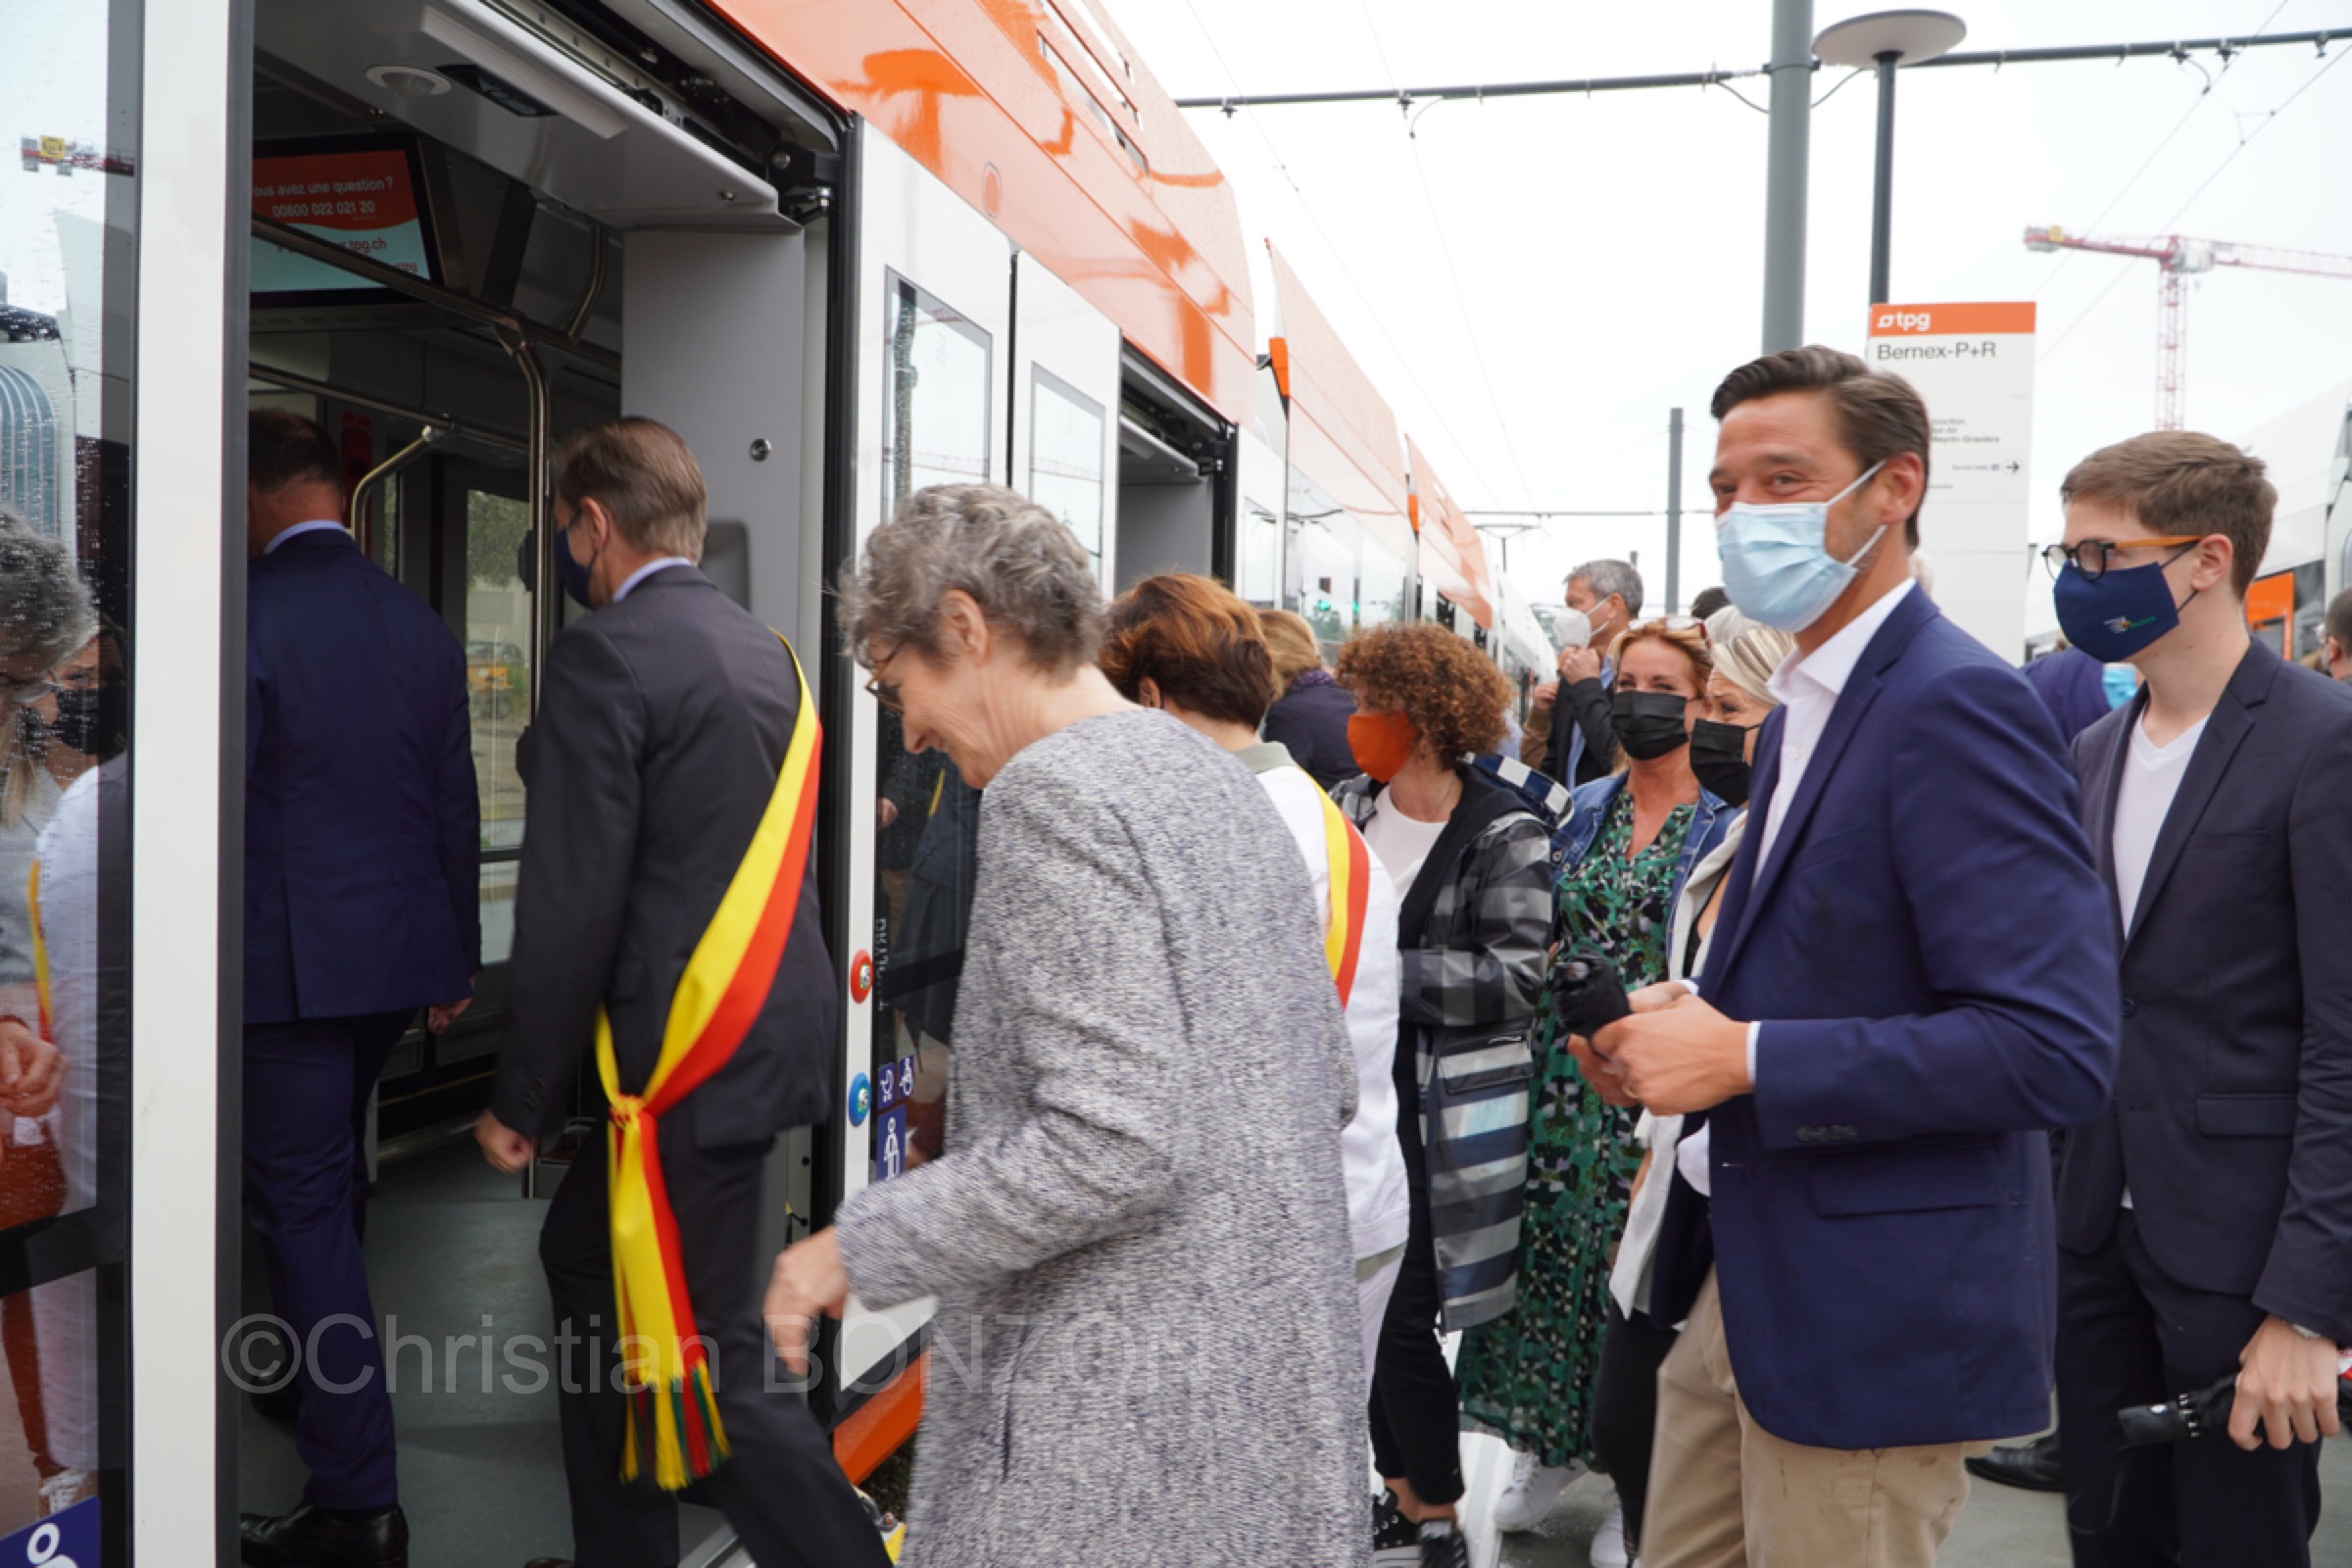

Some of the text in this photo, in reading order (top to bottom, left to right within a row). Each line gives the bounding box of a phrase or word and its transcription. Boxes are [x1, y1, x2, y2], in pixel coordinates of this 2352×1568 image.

[252, 186, 274, 197] ous
[278, 183, 306, 196] avez
[308, 182, 330, 195] une
[333, 178, 385, 196] question
[272, 200, 375, 218] 00800 022 021 20
[1877, 341, 1996, 361] Bernex-P+R
